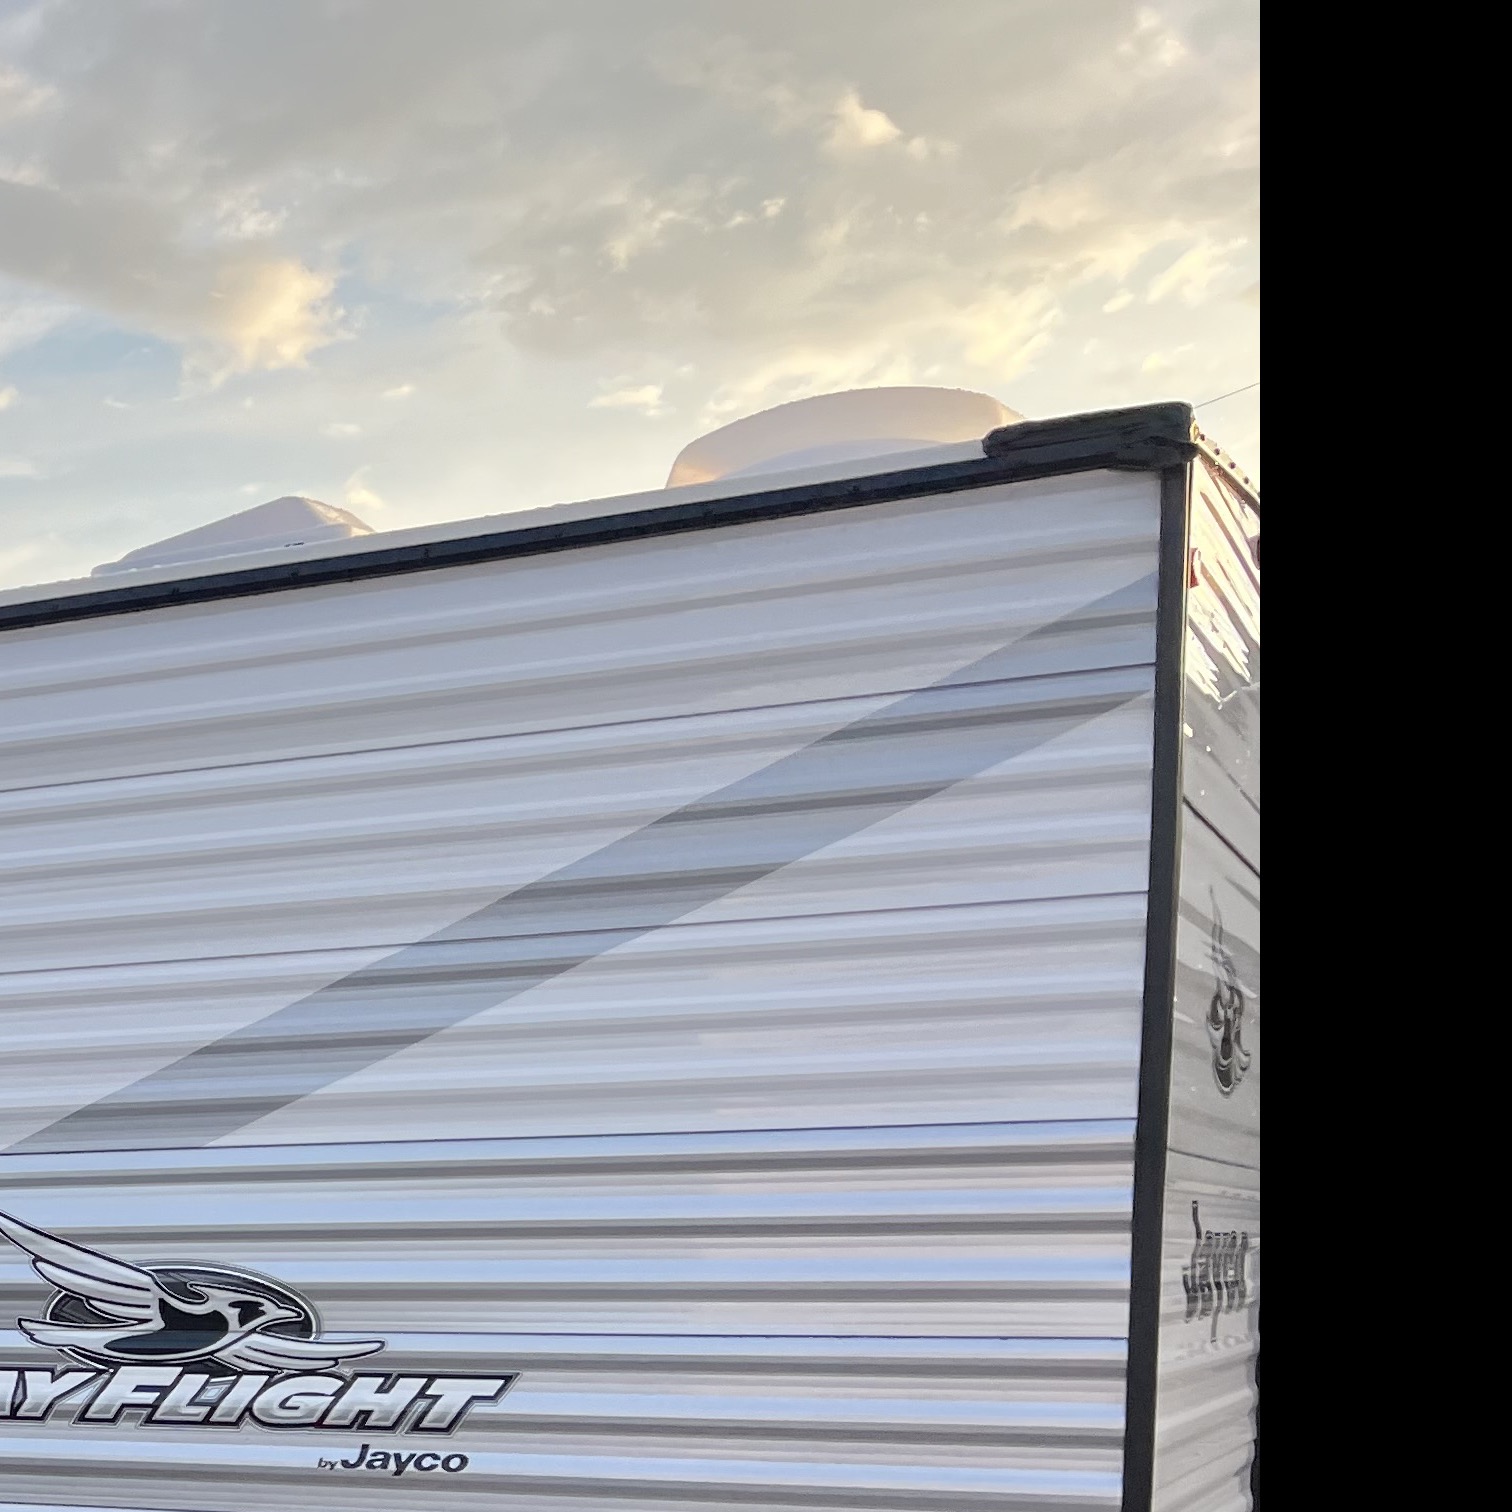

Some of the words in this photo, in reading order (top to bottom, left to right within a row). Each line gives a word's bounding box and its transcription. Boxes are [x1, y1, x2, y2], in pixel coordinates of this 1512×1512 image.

[73, 1364, 523, 1437] FLIGHT
[317, 1457, 338, 1470] by
[340, 1443, 469, 1476] Jayco
